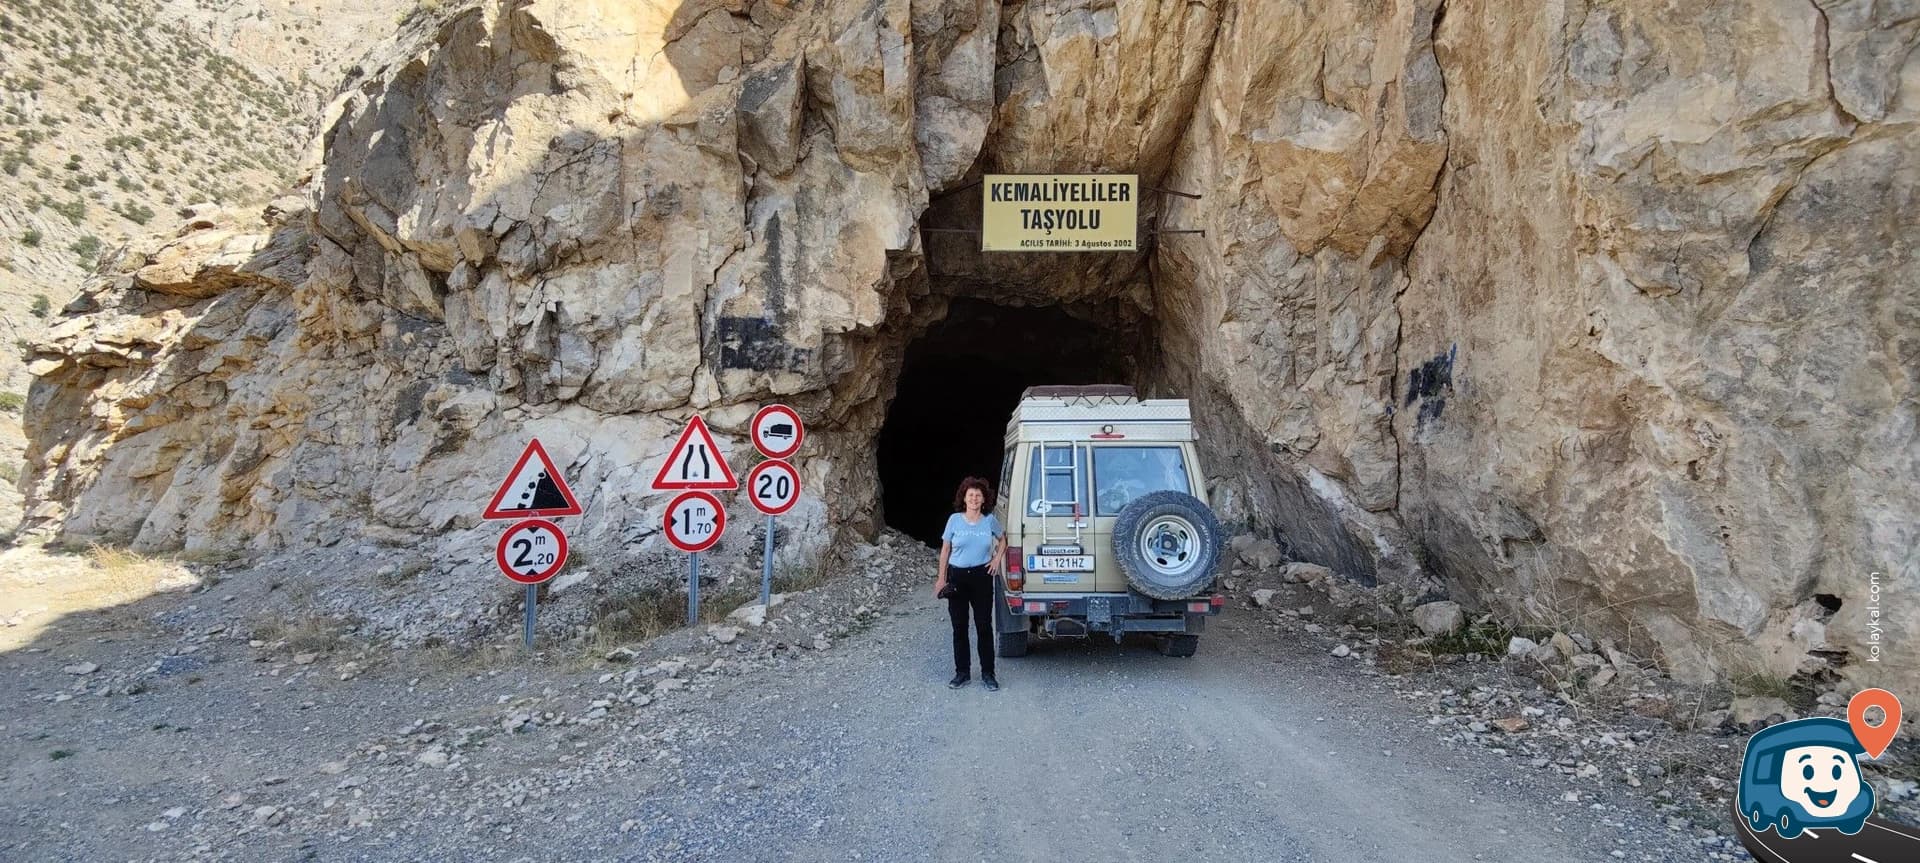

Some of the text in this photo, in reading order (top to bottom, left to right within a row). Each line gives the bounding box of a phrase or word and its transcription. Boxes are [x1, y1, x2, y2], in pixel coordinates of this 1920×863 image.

[991, 179, 1130, 202] KEMALİYELİLER
[1020, 209, 1101, 235] TAŞYOLU
[1075, 239, 1080, 247] 3
[1113, 239, 1132, 247] 2002
[758, 474, 789, 500] 20
[696, 507, 706, 516] m
[535, 535, 546, 546] m
[1041, 558, 1047, 568] L
